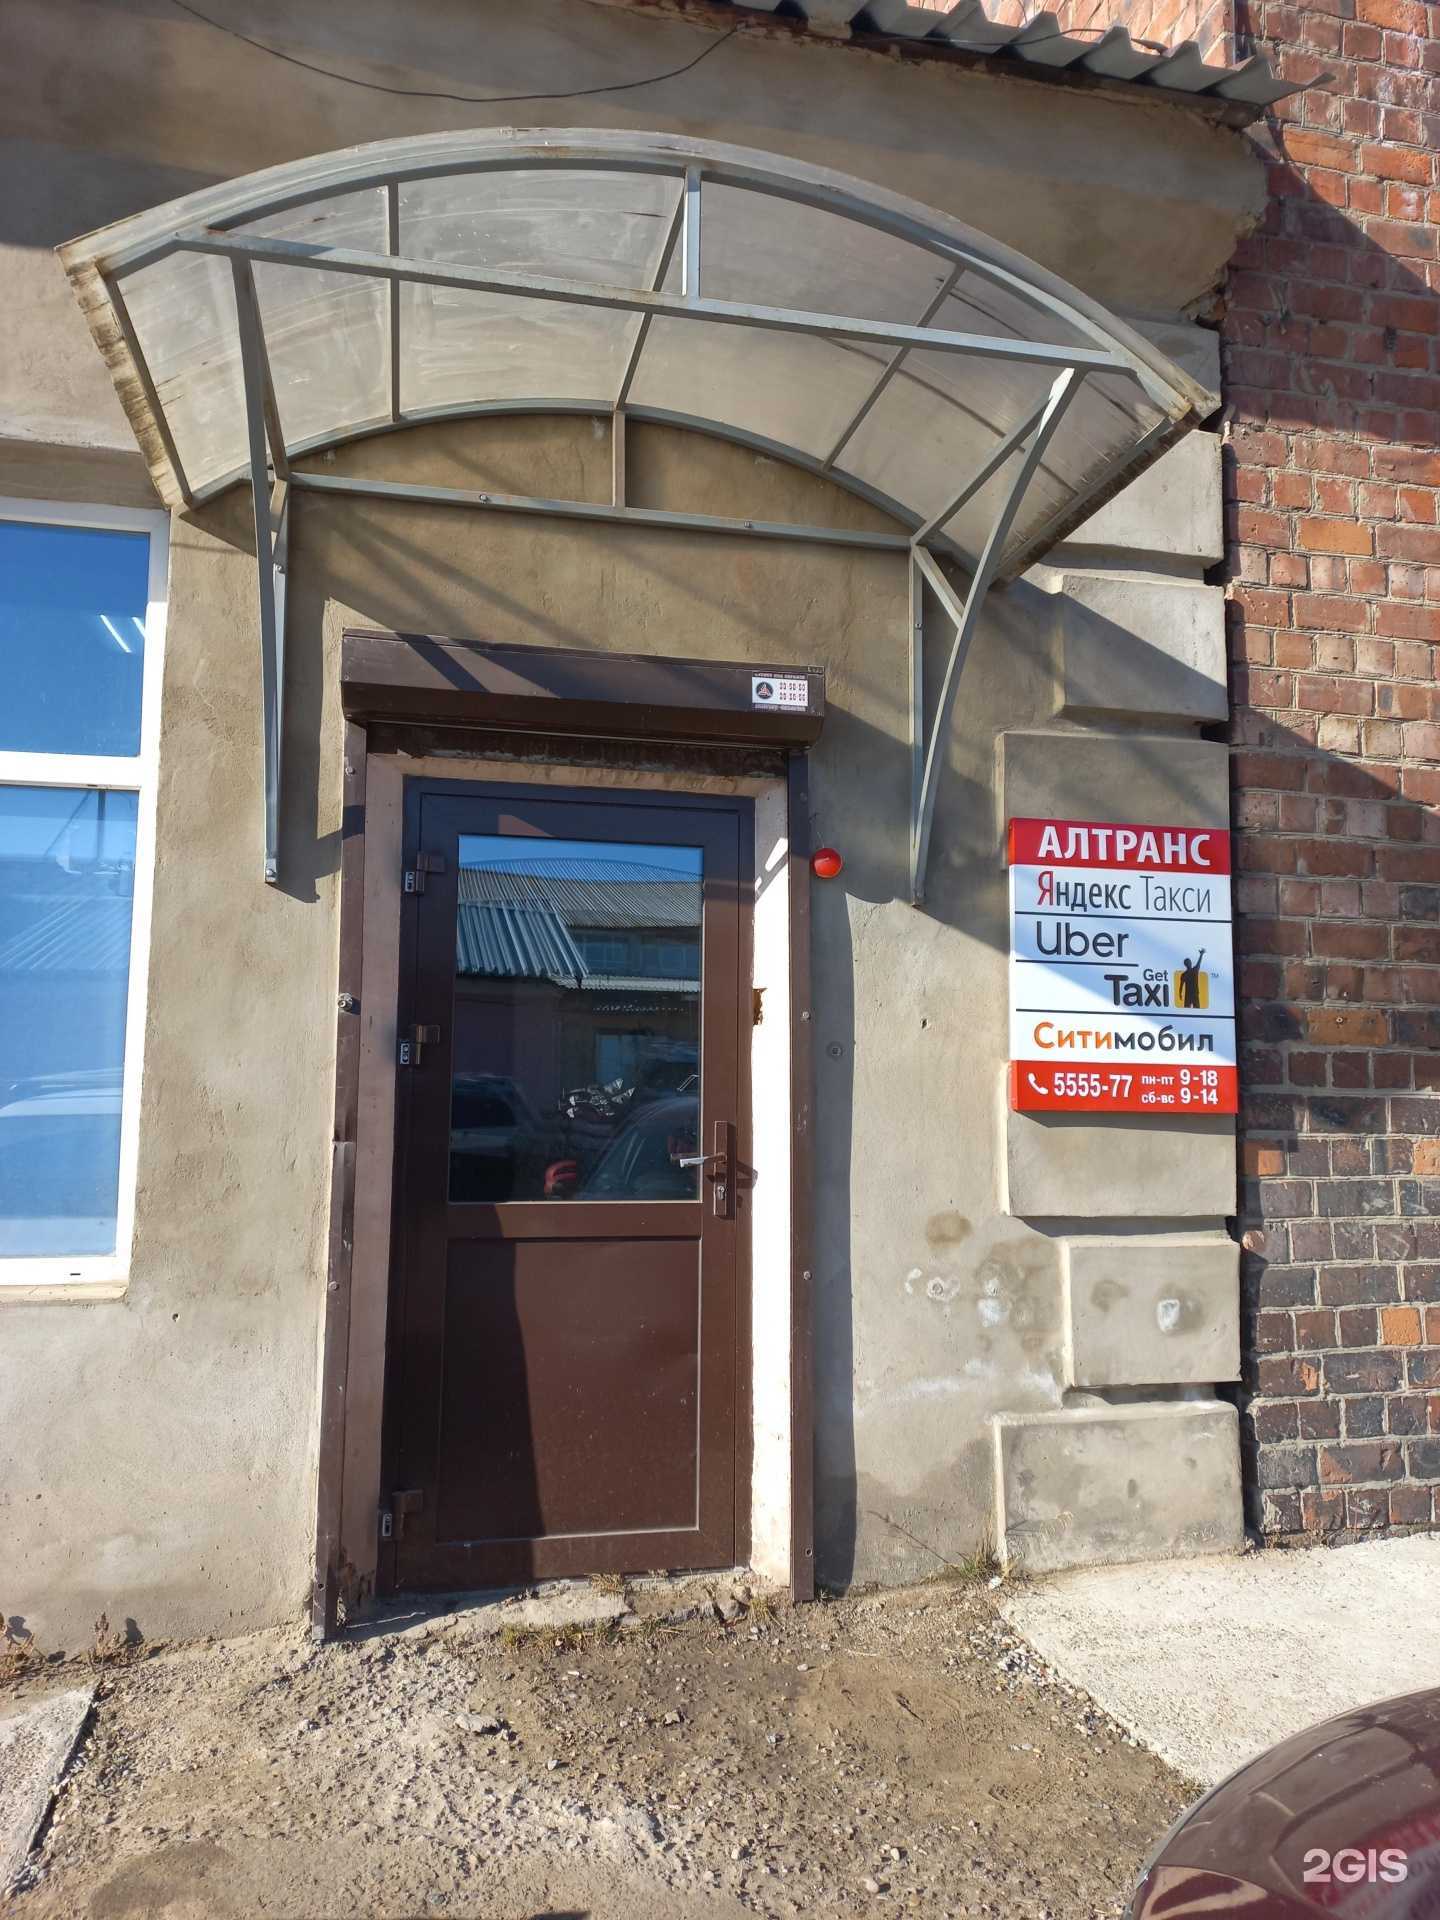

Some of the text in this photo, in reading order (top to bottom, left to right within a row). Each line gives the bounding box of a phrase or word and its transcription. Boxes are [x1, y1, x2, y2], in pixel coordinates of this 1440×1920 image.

[1038, 825, 1211, 866] АЛТРАНС
[1037, 871, 1211, 913] Яндекс Такси
[1036, 921, 1129, 958] Uber
[1104, 974, 1169, 1007] Taxi
[1143, 968, 1169, 982] Get
[1033, 1021, 1214, 1052] Ситимобил
[1054, 1072, 1133, 1098] 5555-77
[1141, 1075, 1174, 1086] пн-пт
[1141, 1091, 1174, 1104] сб-вс
